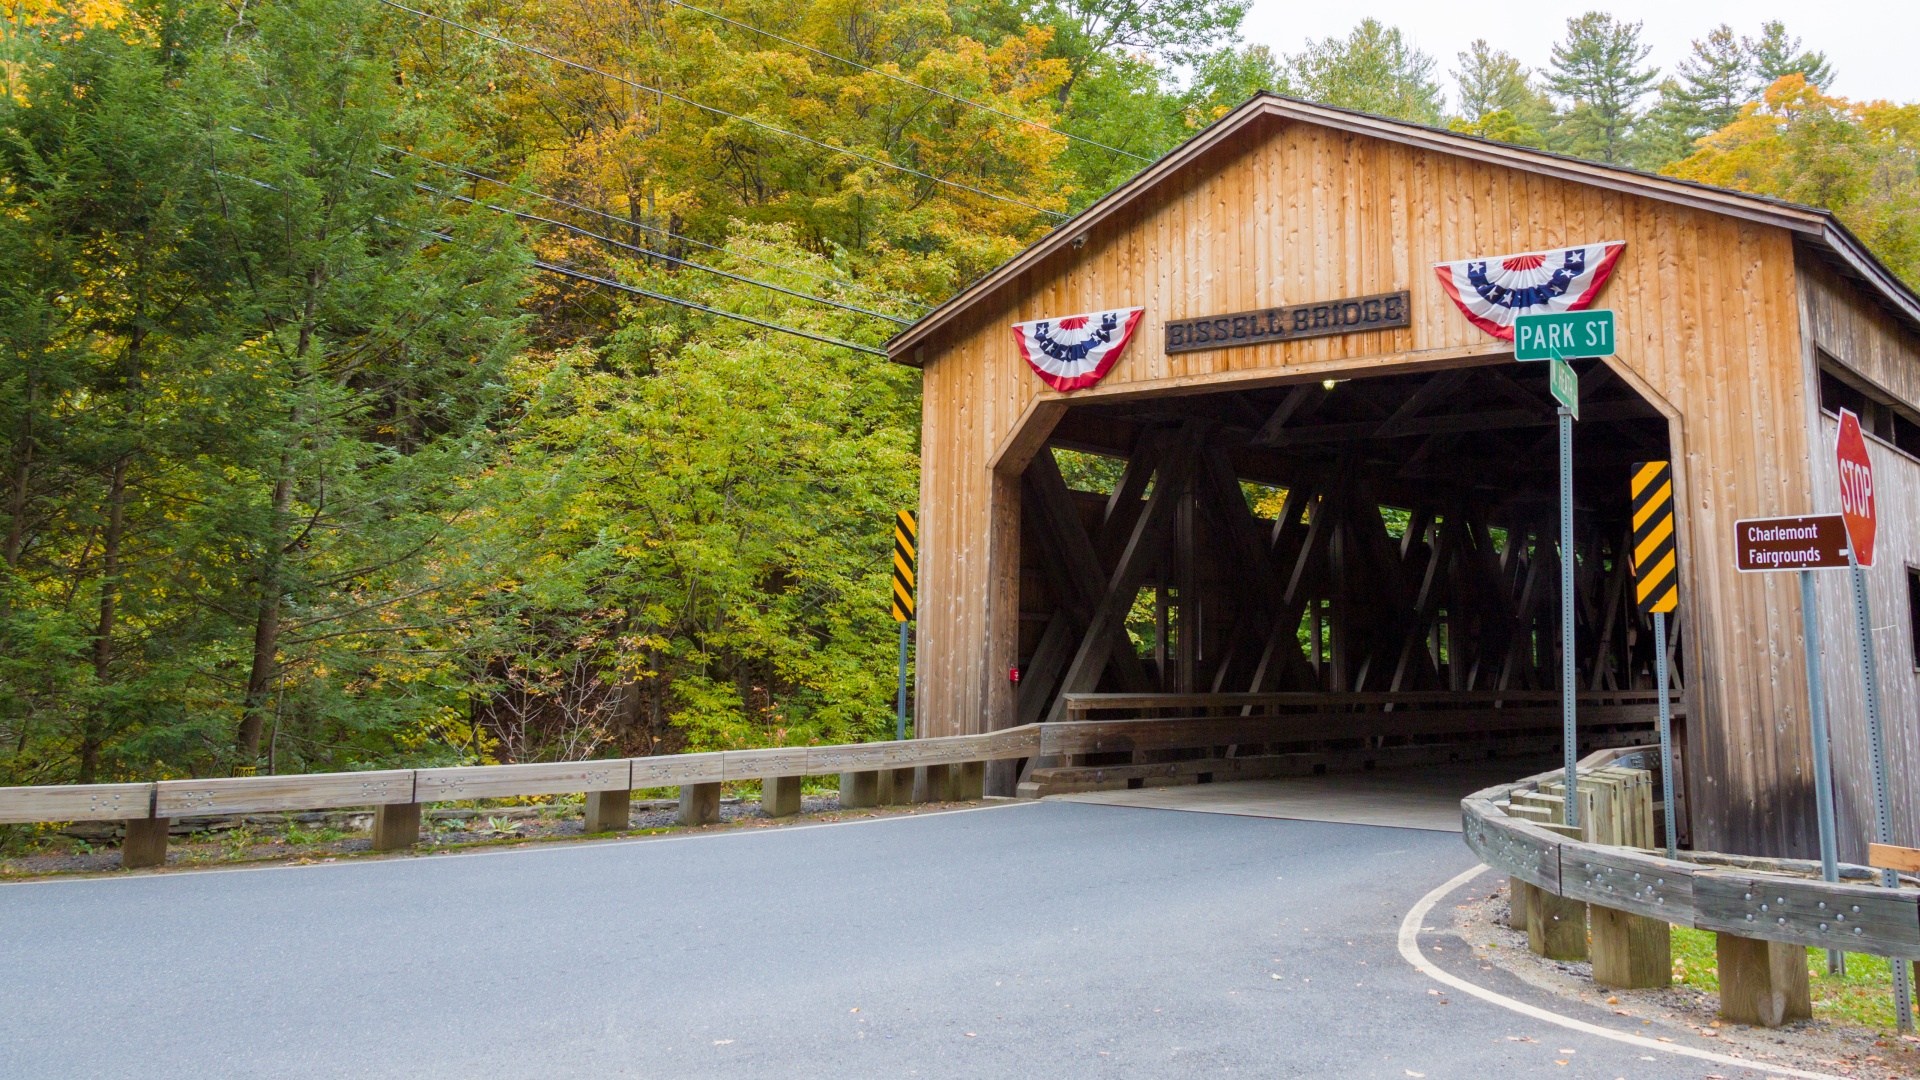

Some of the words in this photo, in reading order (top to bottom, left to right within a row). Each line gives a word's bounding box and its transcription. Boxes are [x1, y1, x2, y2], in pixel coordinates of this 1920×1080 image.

[1168, 313, 1284, 346] BISSELL
[1293, 296, 1402, 332] BRIDGE
[1520, 322, 1576, 350] PARK
[1585, 320, 1609, 347] ST
[1840, 458, 1872, 519] STOP
[1748, 523, 1818, 542] Charlemont
[1748, 546, 1821, 567] Fairgrounds
